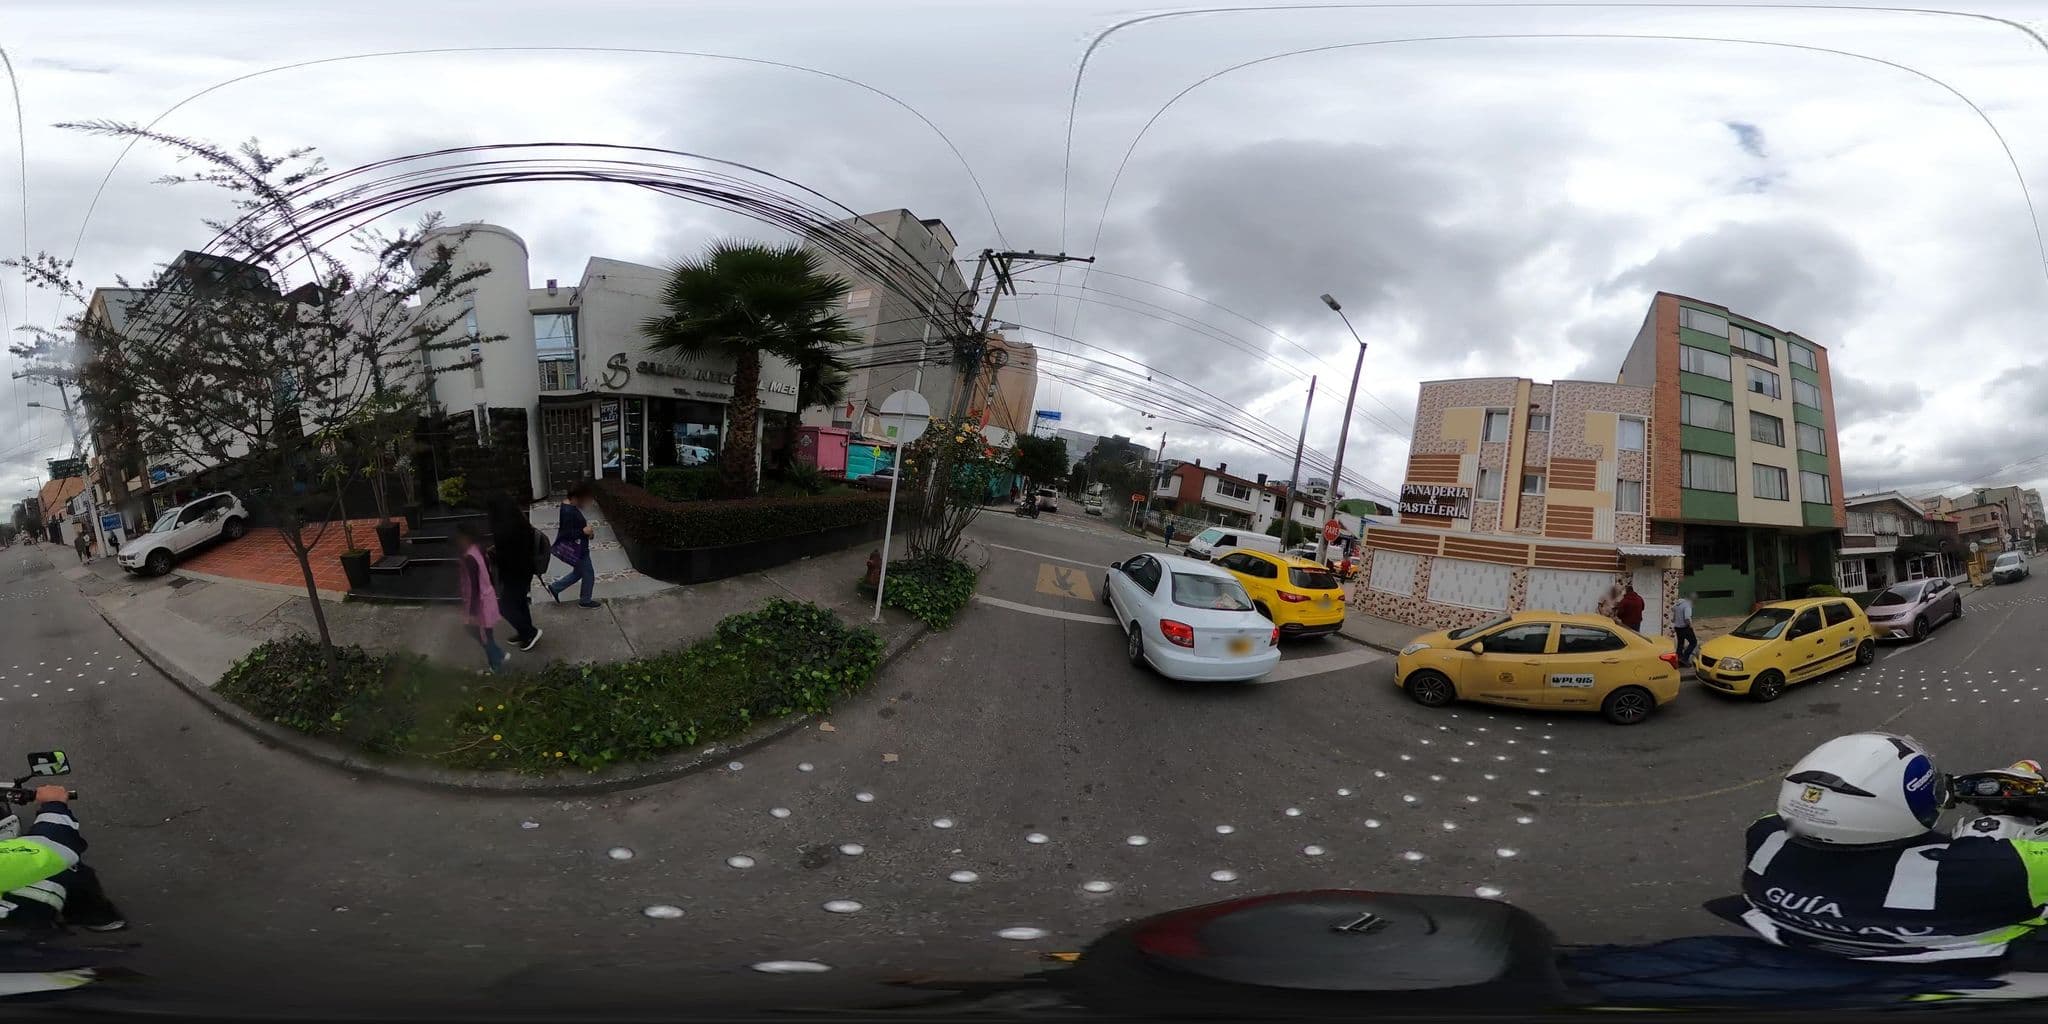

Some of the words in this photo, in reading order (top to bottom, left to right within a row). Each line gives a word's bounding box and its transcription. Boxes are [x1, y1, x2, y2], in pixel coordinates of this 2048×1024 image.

[1402, 484, 1469, 498] PANADERIA
[1428, 495, 1438, 505] &
[1399, 501, 1468, 518] PASTELERIA
[1325, 525, 1340, 536] PARE
[1765, 886, 1843, 918] GUÍA
